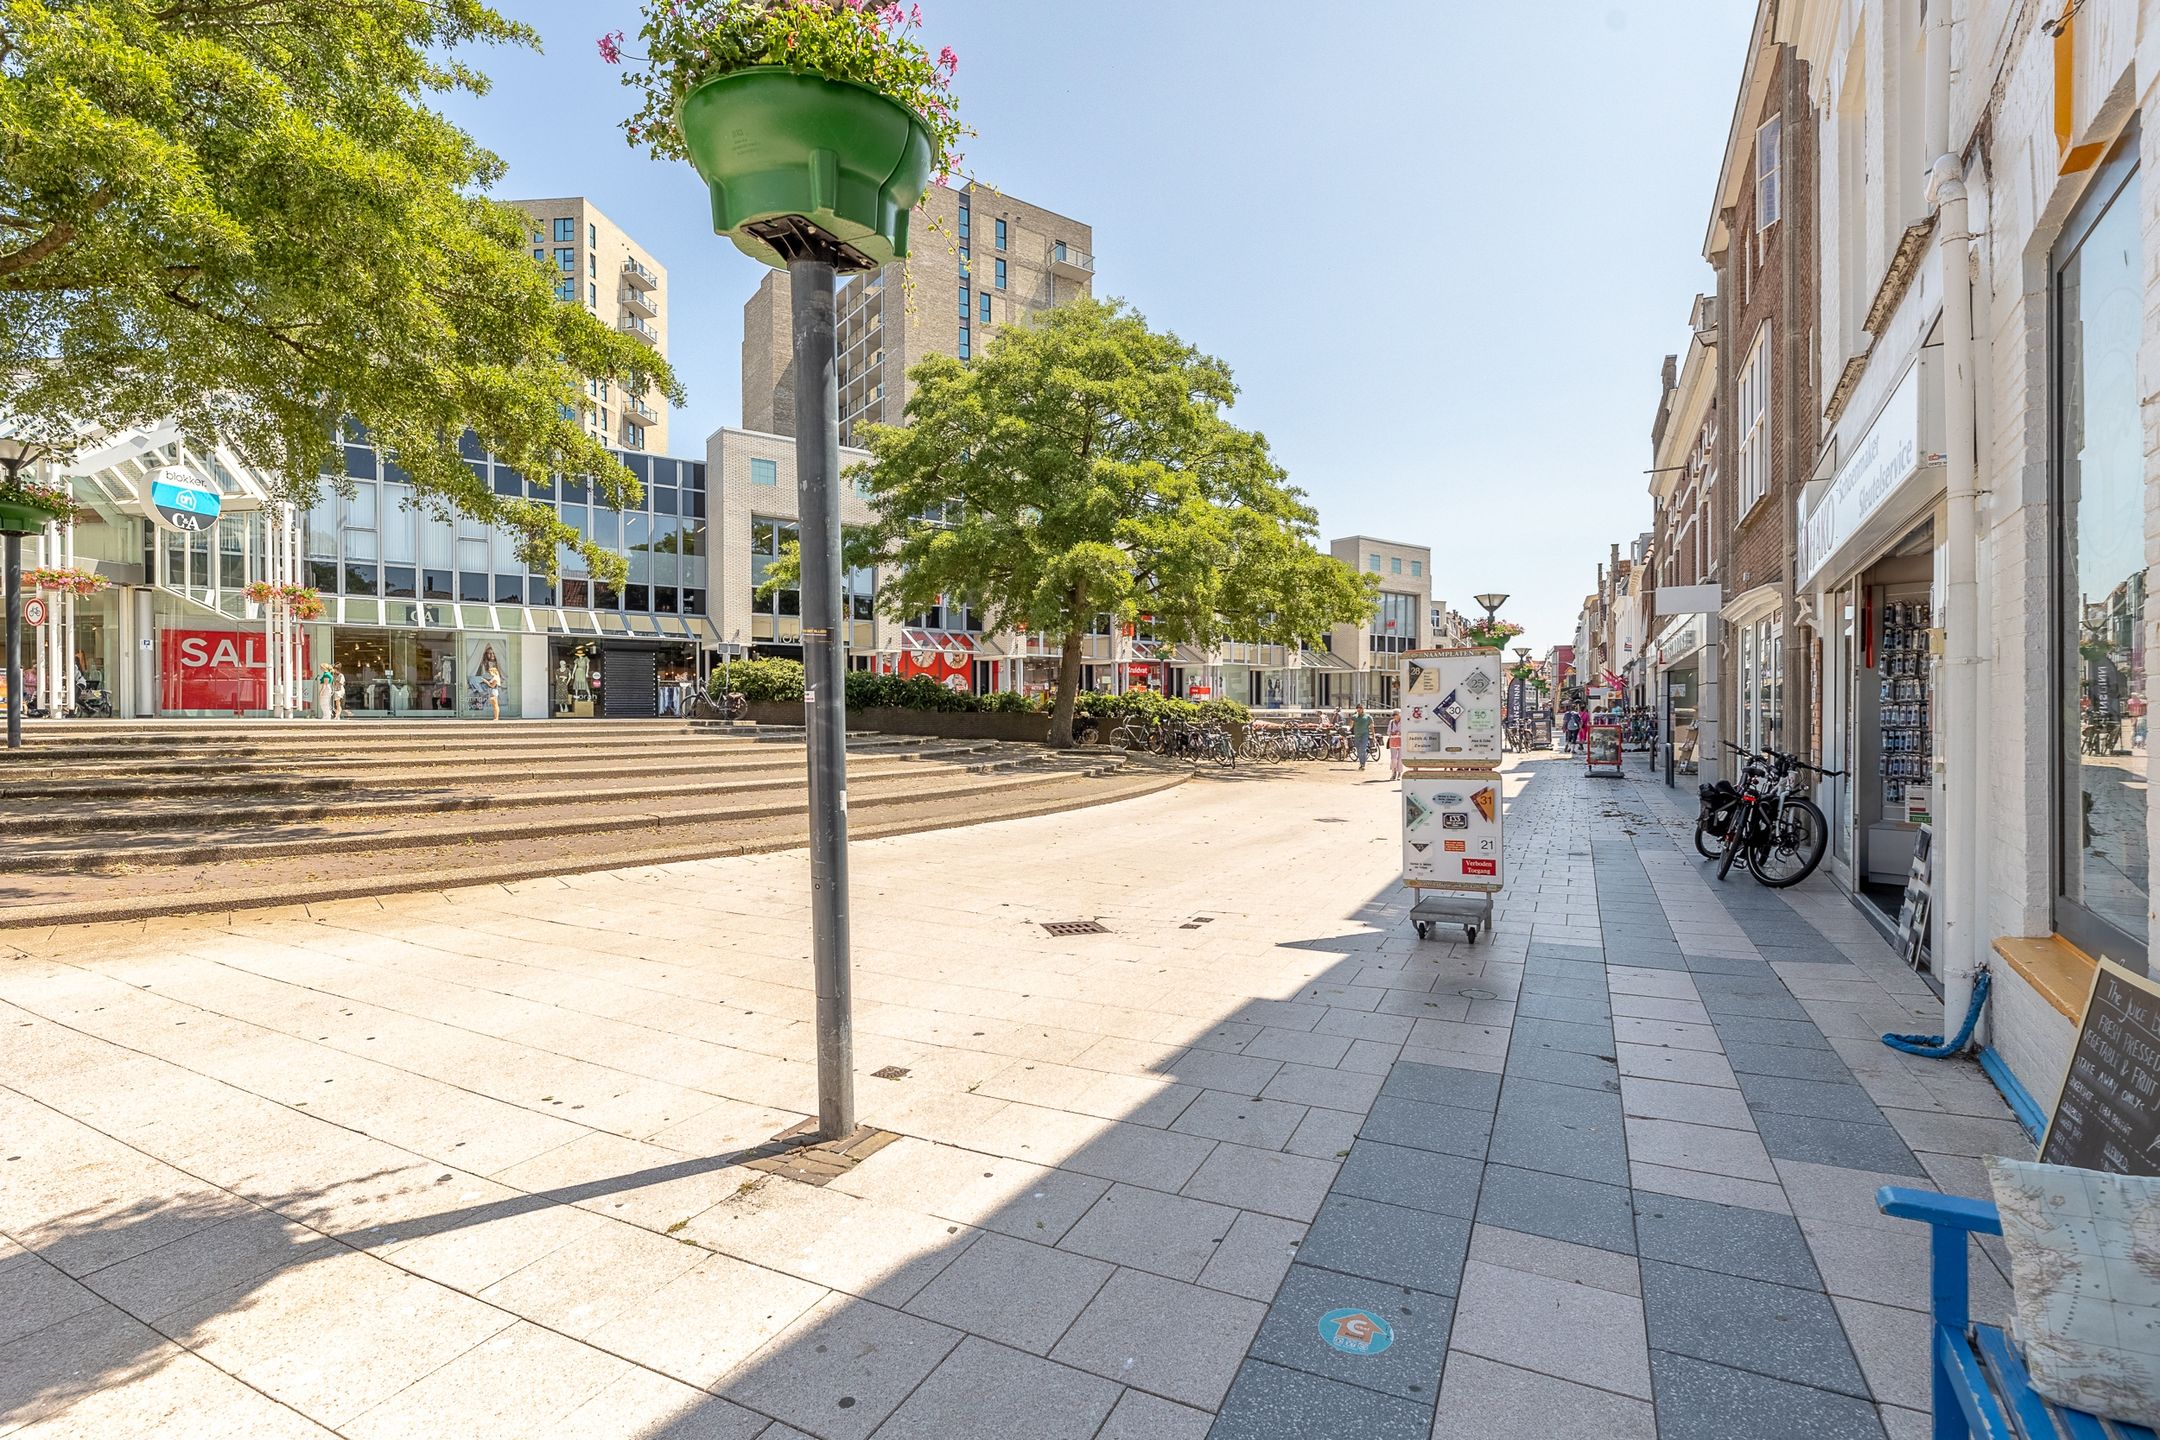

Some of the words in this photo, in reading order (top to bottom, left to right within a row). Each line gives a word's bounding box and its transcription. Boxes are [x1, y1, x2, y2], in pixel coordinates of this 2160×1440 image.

[172, 512, 201, 531] C&A
[181, 637, 269, 668] SAL
[1423, 650, 1474, 658] NAAMPLATEN
[1410, 667, 1421, 676] 28
[1471, 678, 1485, 689] 25
[1449, 706, 1461, 715] 30
[1480, 796, 1492, 805] 31
[1480, 840, 1493, 850] 21
[1465, 860, 1492, 868] Verboden
[1467, 867, 1490, 875] Toegang
[2107, 979, 2122, 1006] The
[2098, 1014, 2122, 1044] FRESH
[2097, 1071, 2118, 1095] AWAY
[2131, 1066, 2158, 1097] FRUIT
